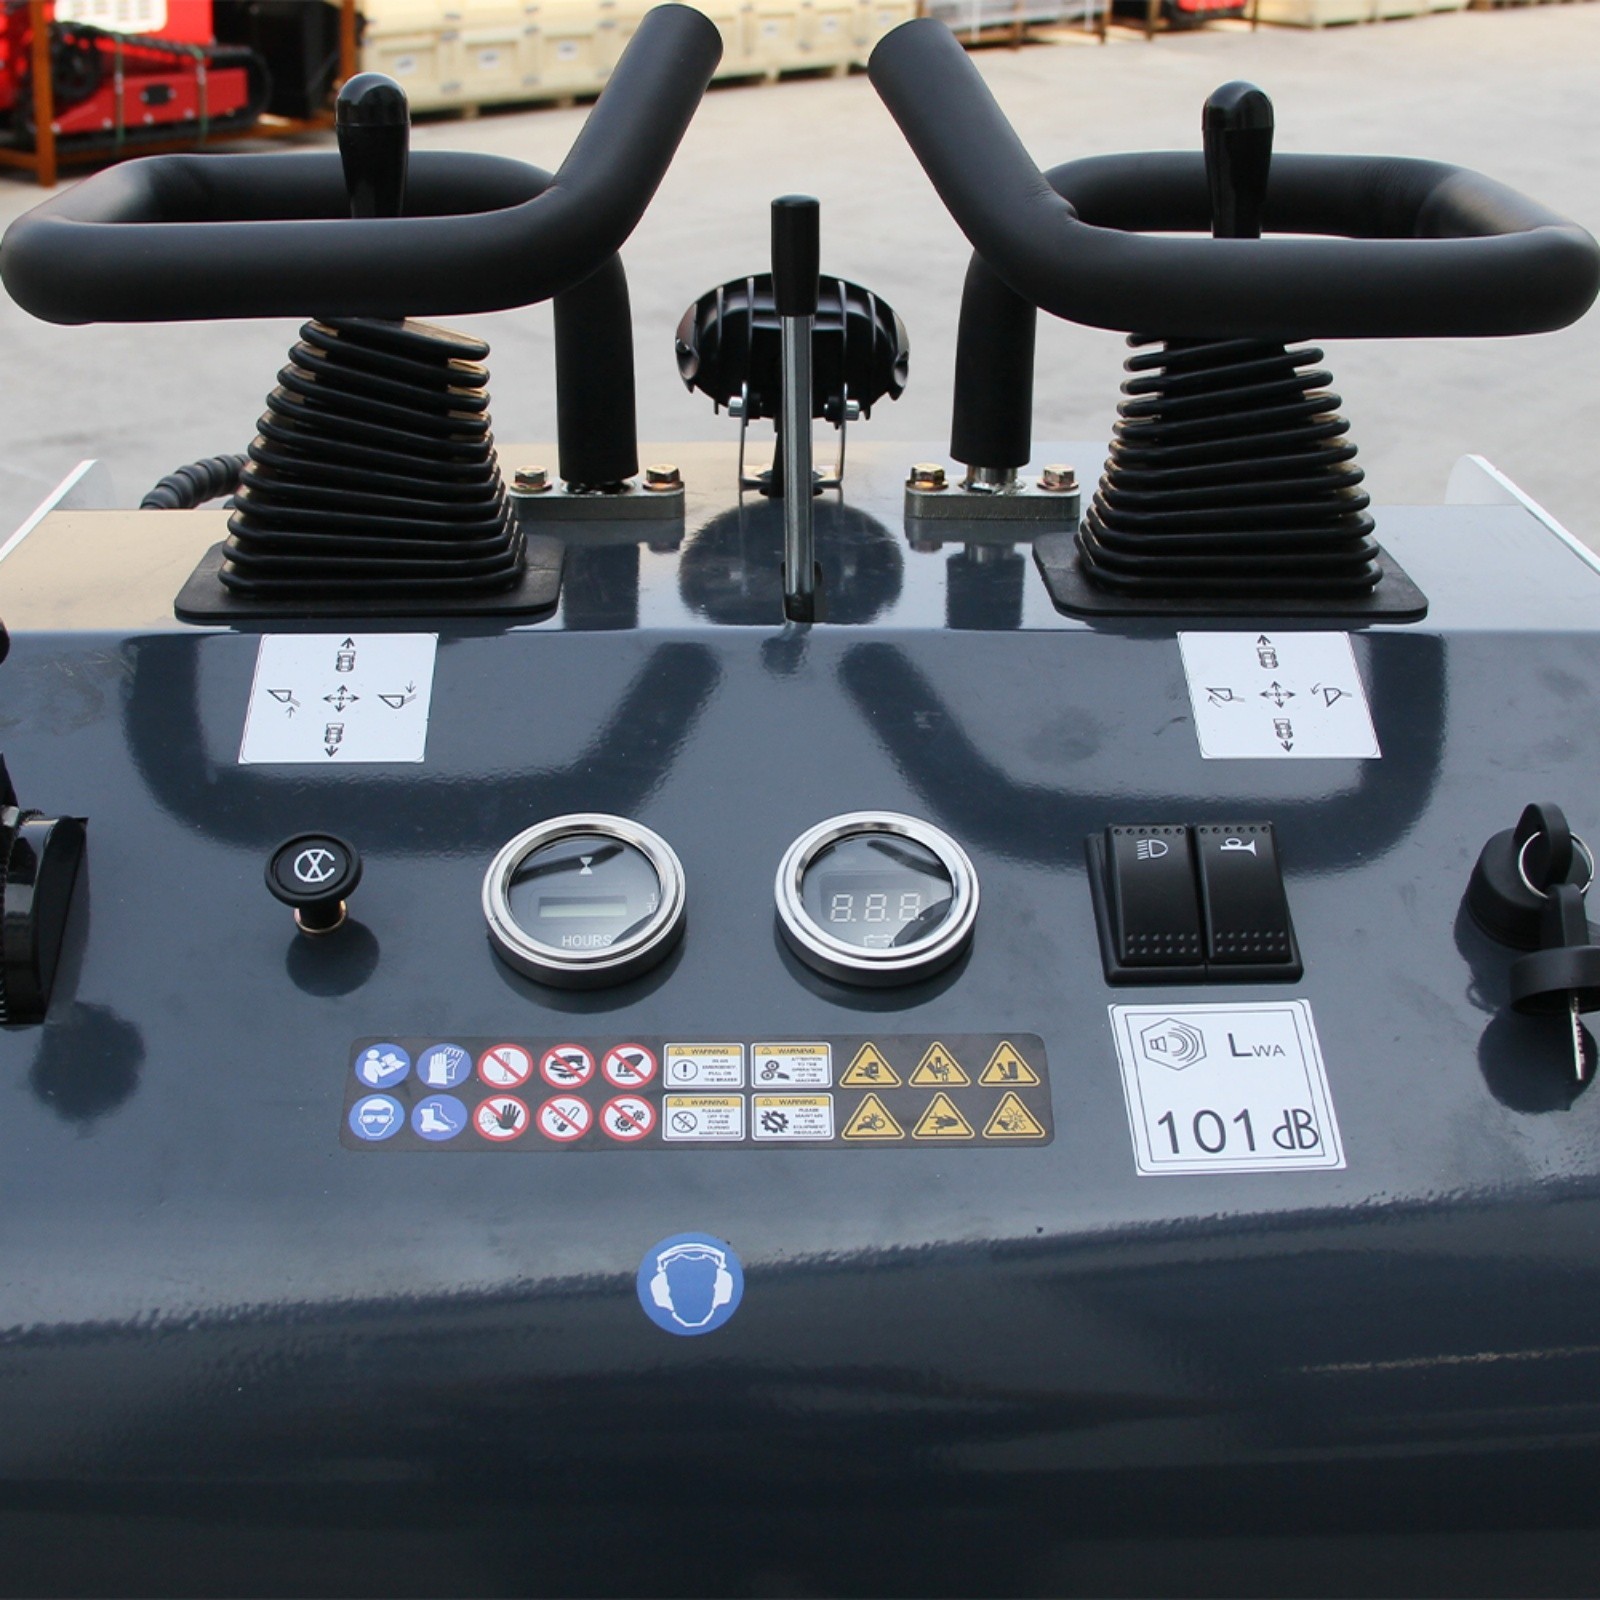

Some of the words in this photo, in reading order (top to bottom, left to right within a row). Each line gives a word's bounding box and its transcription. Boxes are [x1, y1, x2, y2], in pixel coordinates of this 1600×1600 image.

[561, 933, 613, 948] HOURS
[1157, 1108, 1256, 1154] 101
[1272, 1108, 1319, 1150] dB
